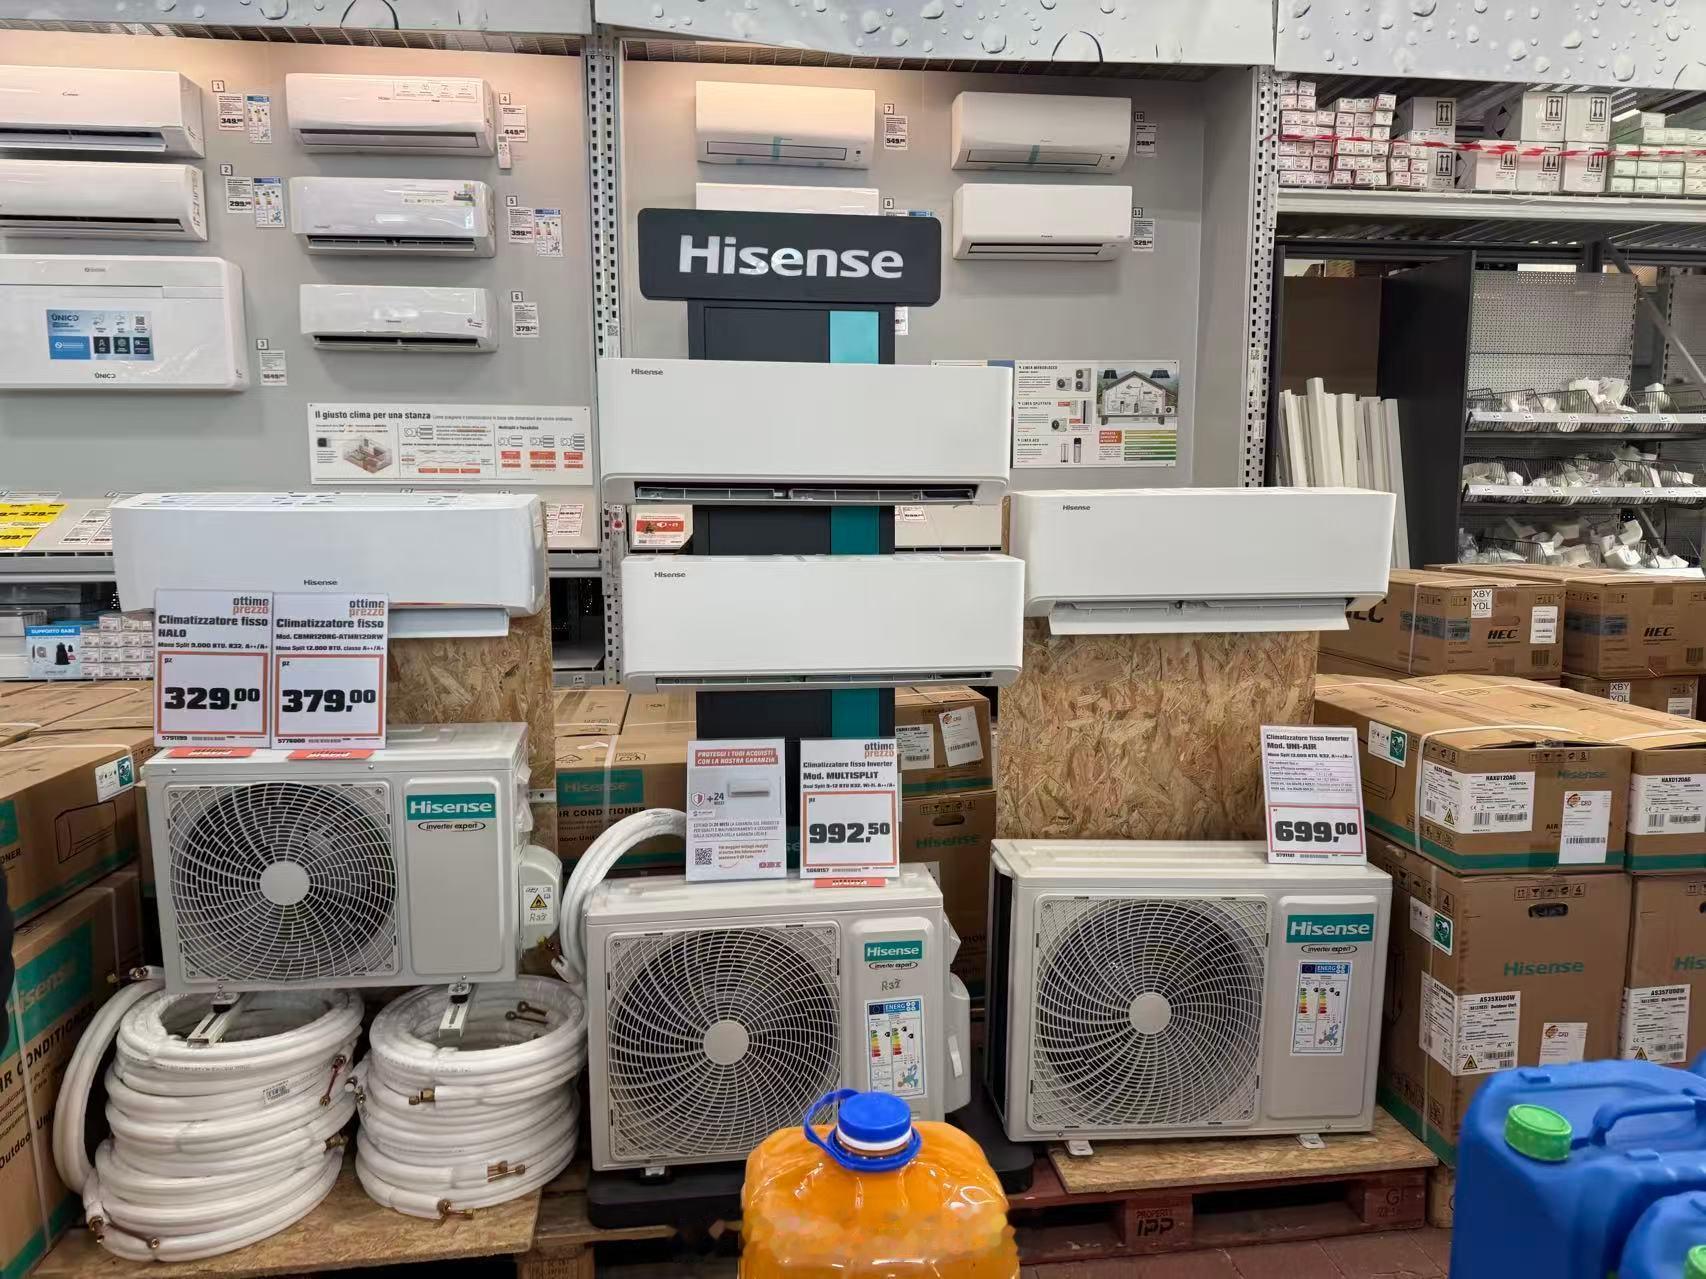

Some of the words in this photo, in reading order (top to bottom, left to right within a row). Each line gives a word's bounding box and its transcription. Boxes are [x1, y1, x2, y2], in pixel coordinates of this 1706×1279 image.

[679, 235, 904, 279] Hisense
[315, 411, 321, 419] Il
[322, 411, 347, 420] giusto
[349, 411, 371, 419] clima
[373, 412, 386, 420] per
[405, 411, 431, 420] stanza
[1472, 590, 1492, 598] XBY
[233, 596, 269, 606] ottimo
[349, 599, 385, 609] ottimo
[1472, 602, 1491, 610] YDL
[232, 605, 268, 615] prezzo
[349, 608, 385, 618] prezzo
[158, 615, 238, 626] Climatizzatore
[241, 616, 268, 626] fisso
[276, 618, 354, 628] Climatizzatore
[357, 618, 384, 628] fisso
[158, 629, 187, 638] HALO
[1487, 629, 1518, 640] HEC
[1643, 626, 1675, 637] HEC
[1610, 683, 1630, 691] XBY
[864, 742, 894, 751] ottimo
[864, 750, 894, 759] prezzo
[803, 772, 824, 780] Mod.
[826, 771, 879, 780] MULTISPLIT
[410, 800, 492, 814] Hisense
[454, 823, 478, 832] expert
[1575, 885, 1582, 895] 4
[1290, 921, 1370, 936] Hisense
[867, 946, 919, 957] Hisense
[1307, 945, 1330, 953] inverter
[1331, 945, 1351, 954] expert
[1503, 961, 1585, 976] Hisense
[1137, 1217, 1174, 1237] IPP
